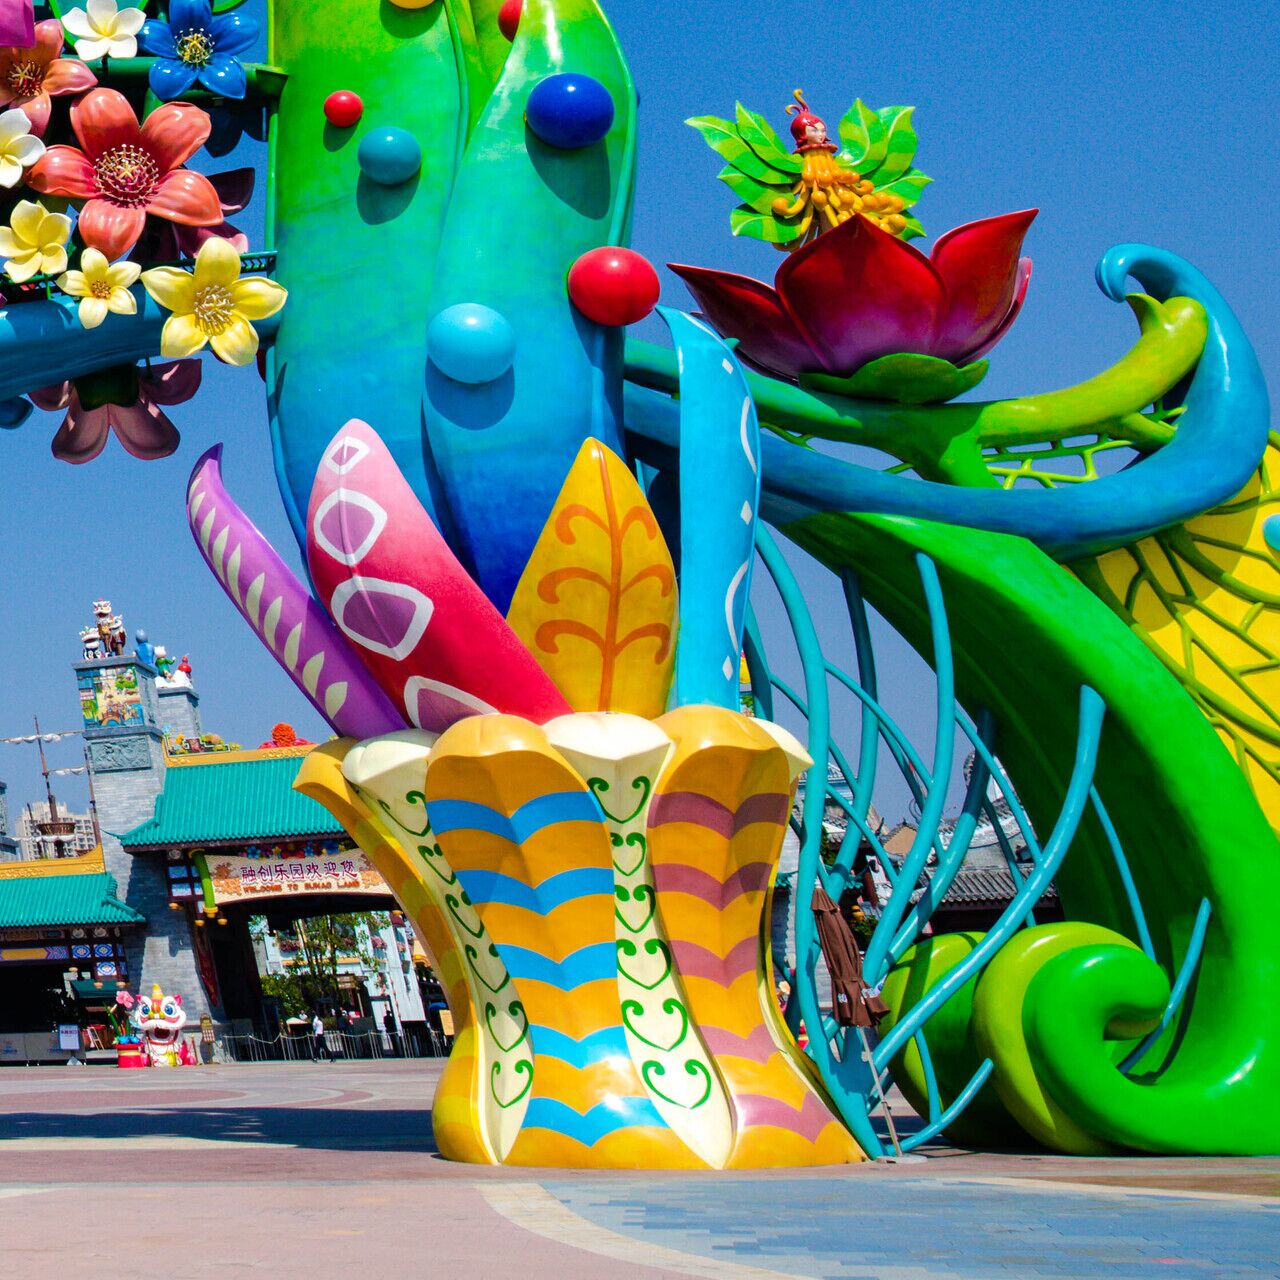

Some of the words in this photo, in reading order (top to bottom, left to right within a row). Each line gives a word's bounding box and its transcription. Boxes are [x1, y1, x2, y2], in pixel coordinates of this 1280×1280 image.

[240, 859, 359, 883] 融创乐园欢迎您
[287, 883, 299, 892] TO
